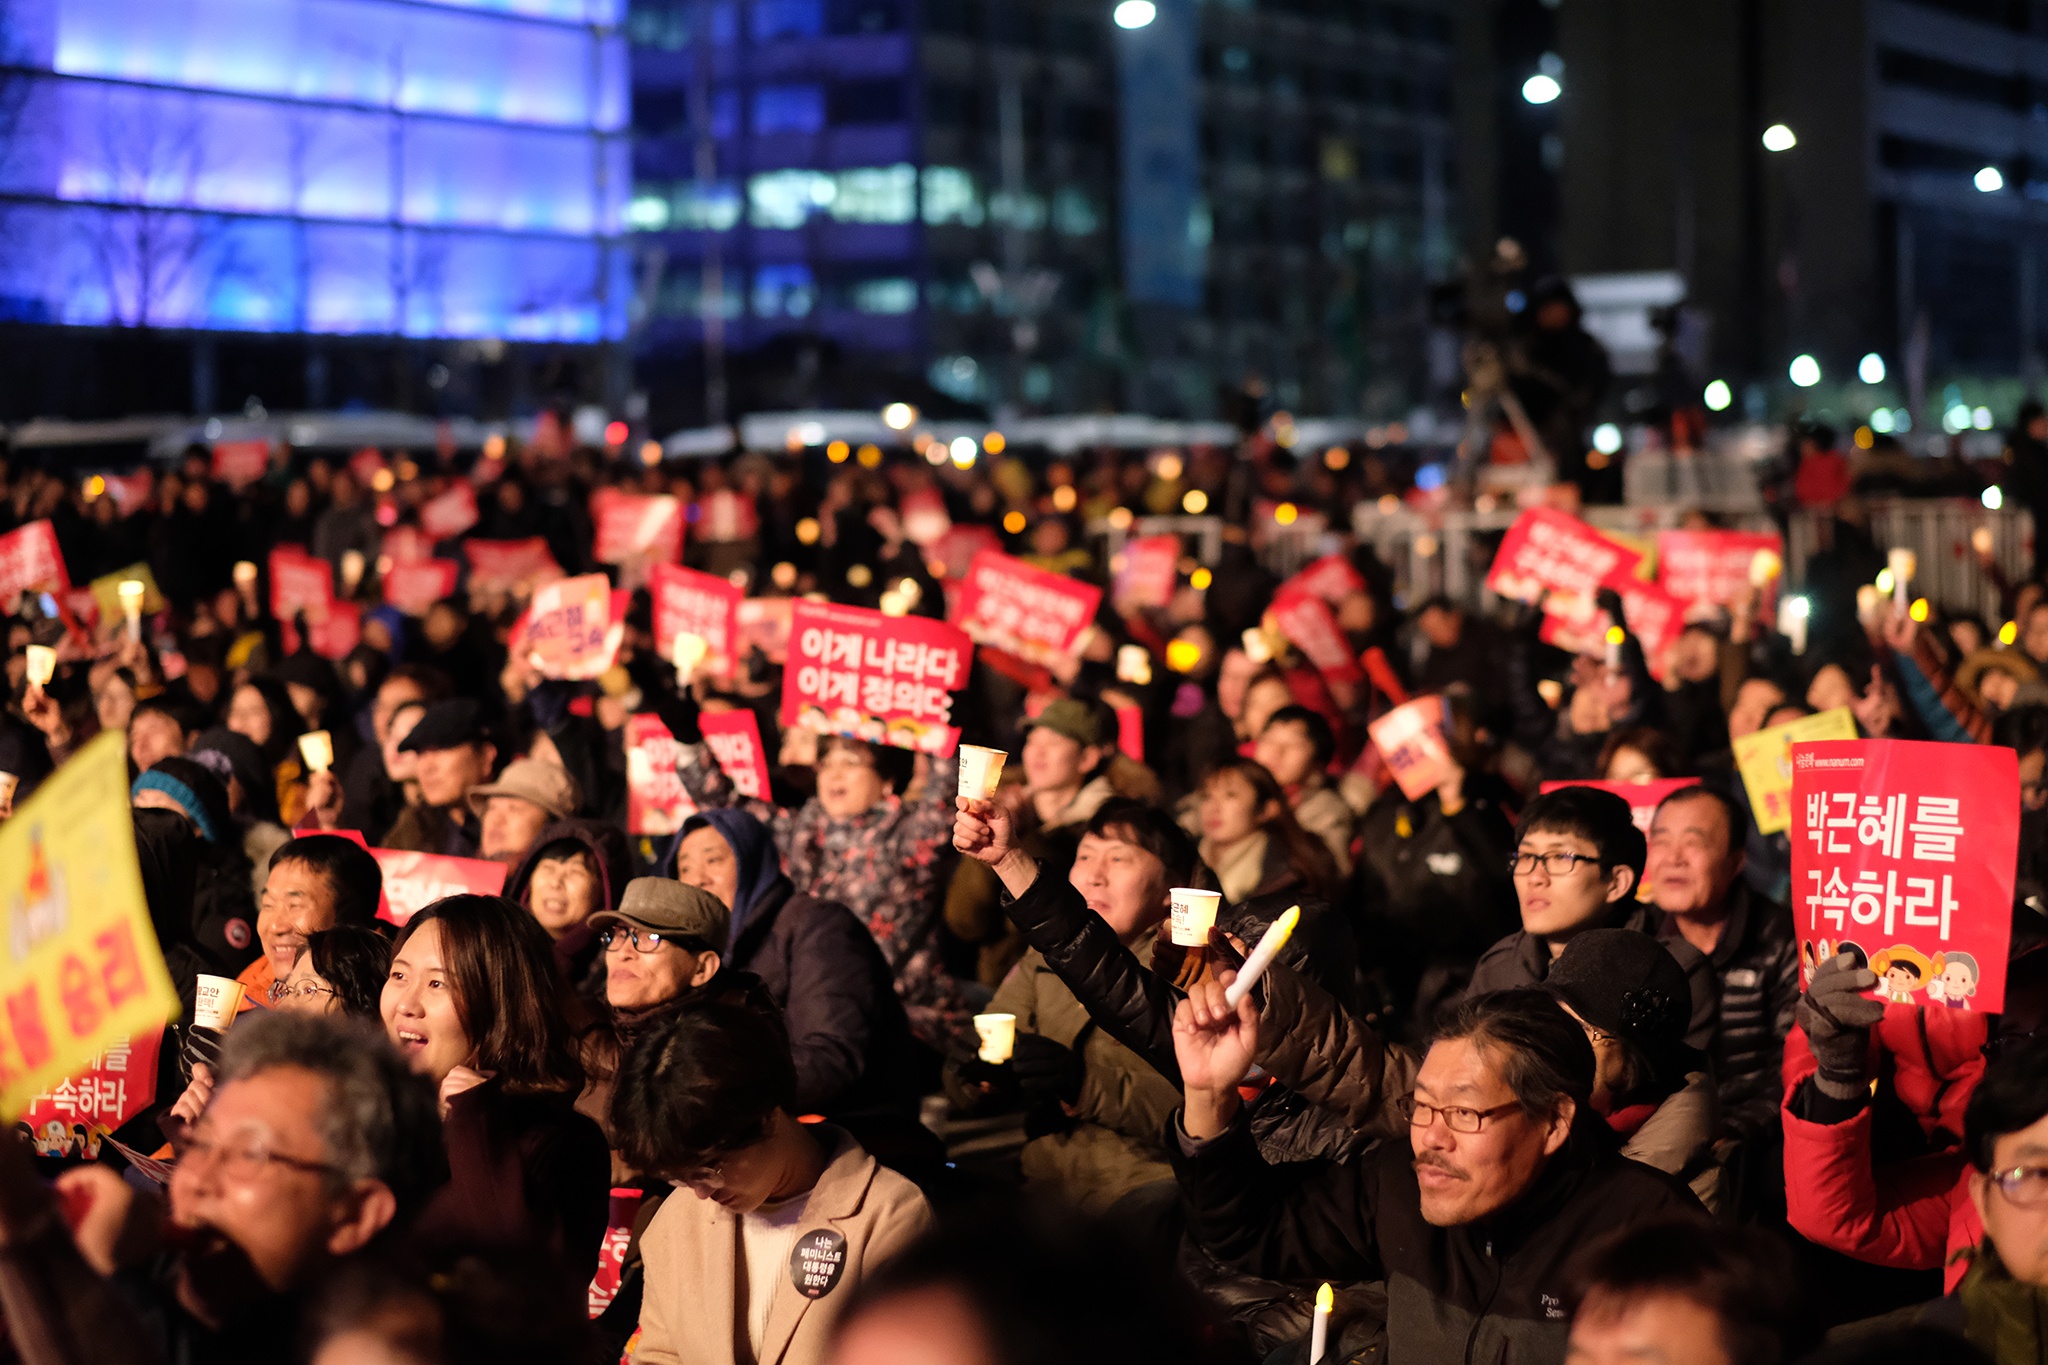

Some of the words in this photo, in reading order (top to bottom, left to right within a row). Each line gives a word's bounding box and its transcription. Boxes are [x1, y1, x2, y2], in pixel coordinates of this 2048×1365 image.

[801, 628, 863, 671] 이게
[864, 638, 960, 686] 나라다
[797, 666, 860, 707] 이게
[1814, 757, 1865, 768] www.nanum.com
[1807, 791, 1964, 862] 박근혜를
[1806, 867, 1959, 940] 구속하라
[815, 1236, 833, 1249] 나는
[800, 1247, 842, 1262] 페미니스트
[802, 1261, 835, 1276] 대통령을
[804, 1273, 828, 1287] 원한다
[1541, 1294, 1559, 1306] Pro
